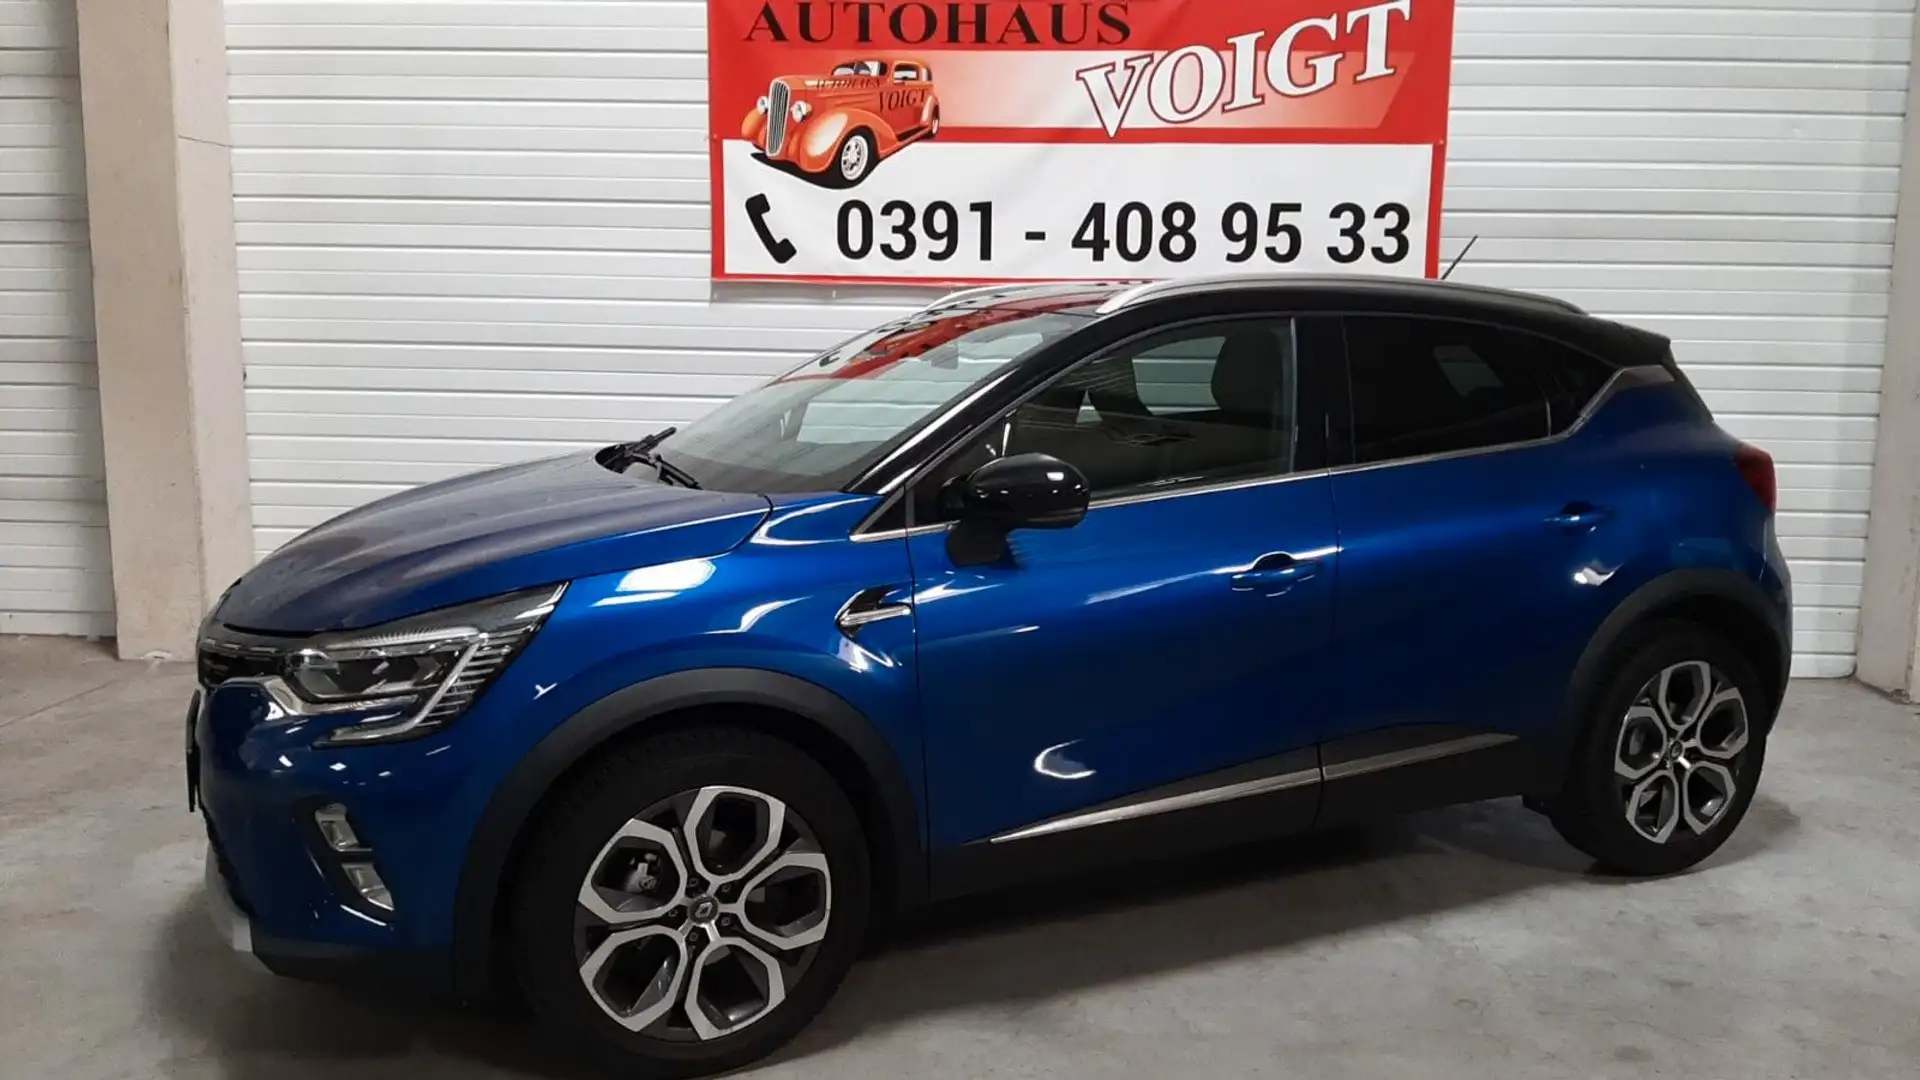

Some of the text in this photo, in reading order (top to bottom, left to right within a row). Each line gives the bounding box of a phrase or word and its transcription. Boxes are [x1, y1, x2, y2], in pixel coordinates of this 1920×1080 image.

[744, 1, 1132, 45] AUTOHAUS
[1076, 0, 1412, 138] VOIGT
[879, 88, 927, 112] VOIGT
[837, 200, 994, 262] 0391
[1071, 201, 1197, 263] 408
[1221, 201, 1302, 264] 95
[1327, 202, 1410, 264] 33
